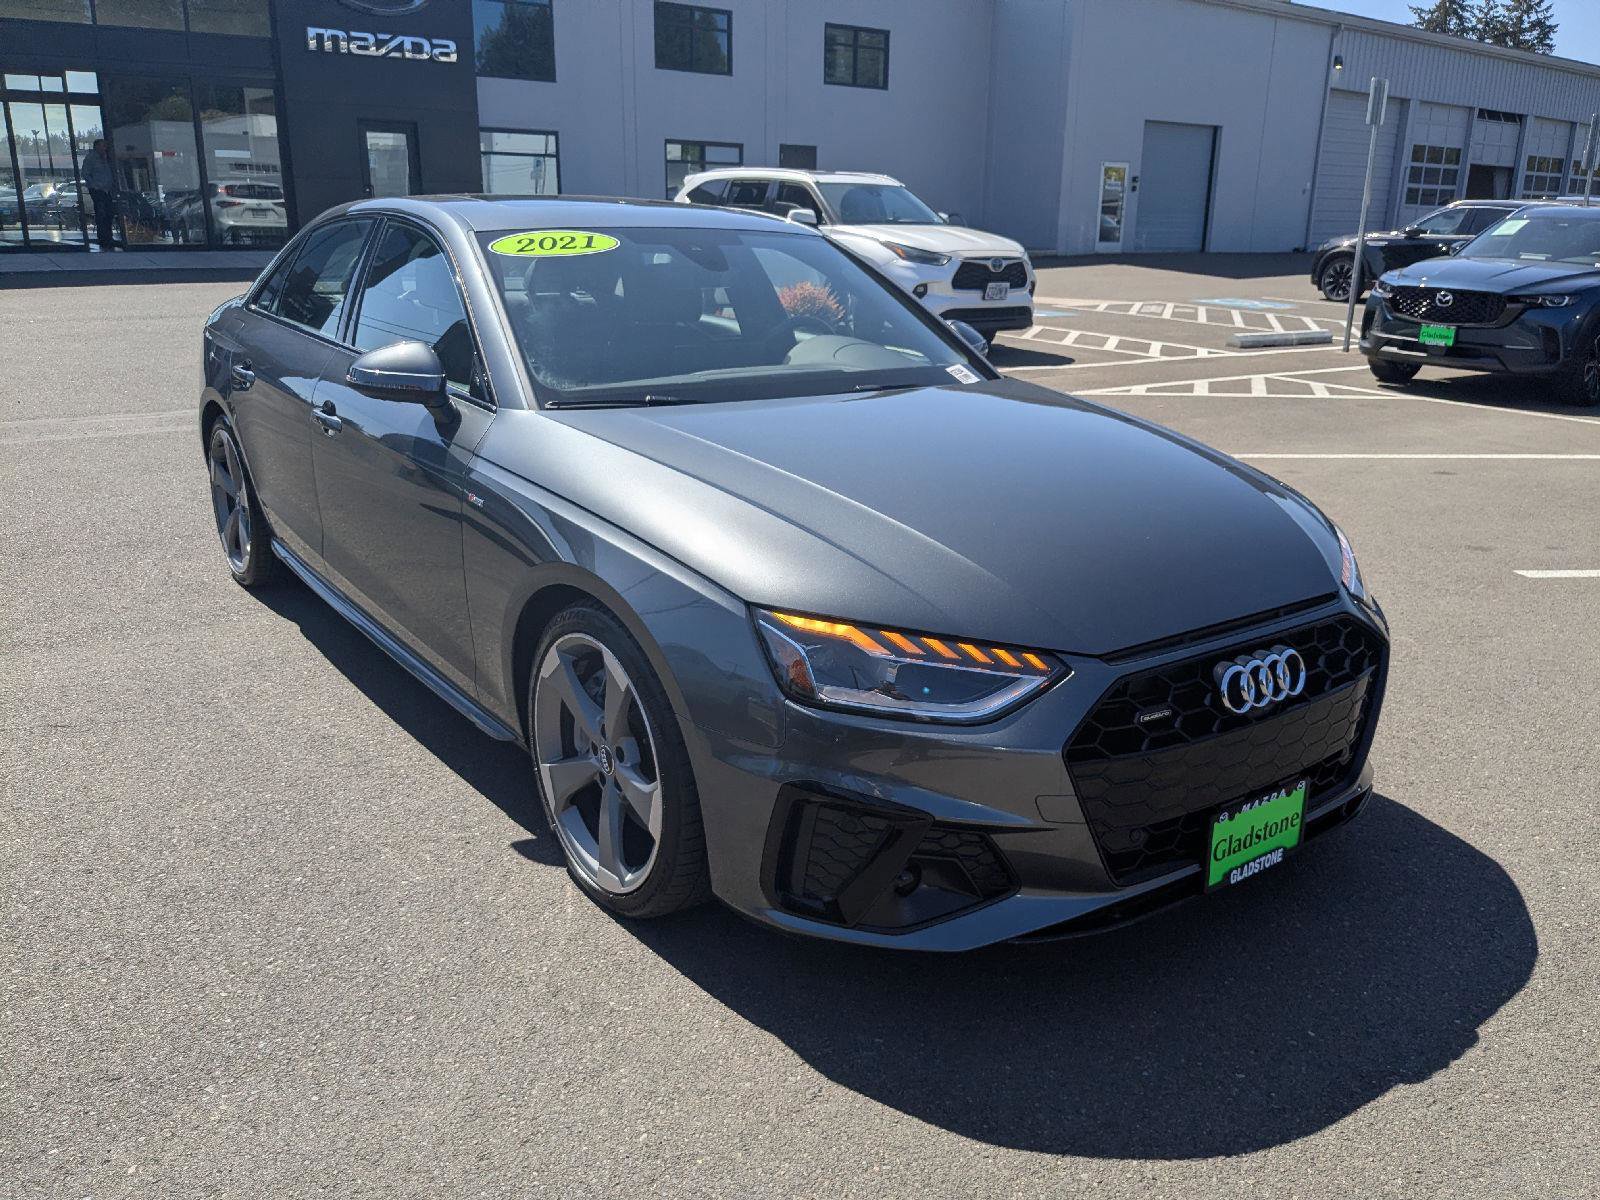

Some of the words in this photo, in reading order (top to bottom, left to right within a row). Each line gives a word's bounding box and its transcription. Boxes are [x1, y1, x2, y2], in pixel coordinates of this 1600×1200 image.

[516, 235, 597, 253] 2021
[1241, 788, 1287, 812] MAZDA
[1213, 811, 1300, 862] Gladstone
[1230, 847, 1284, 884] GLADSTONE
